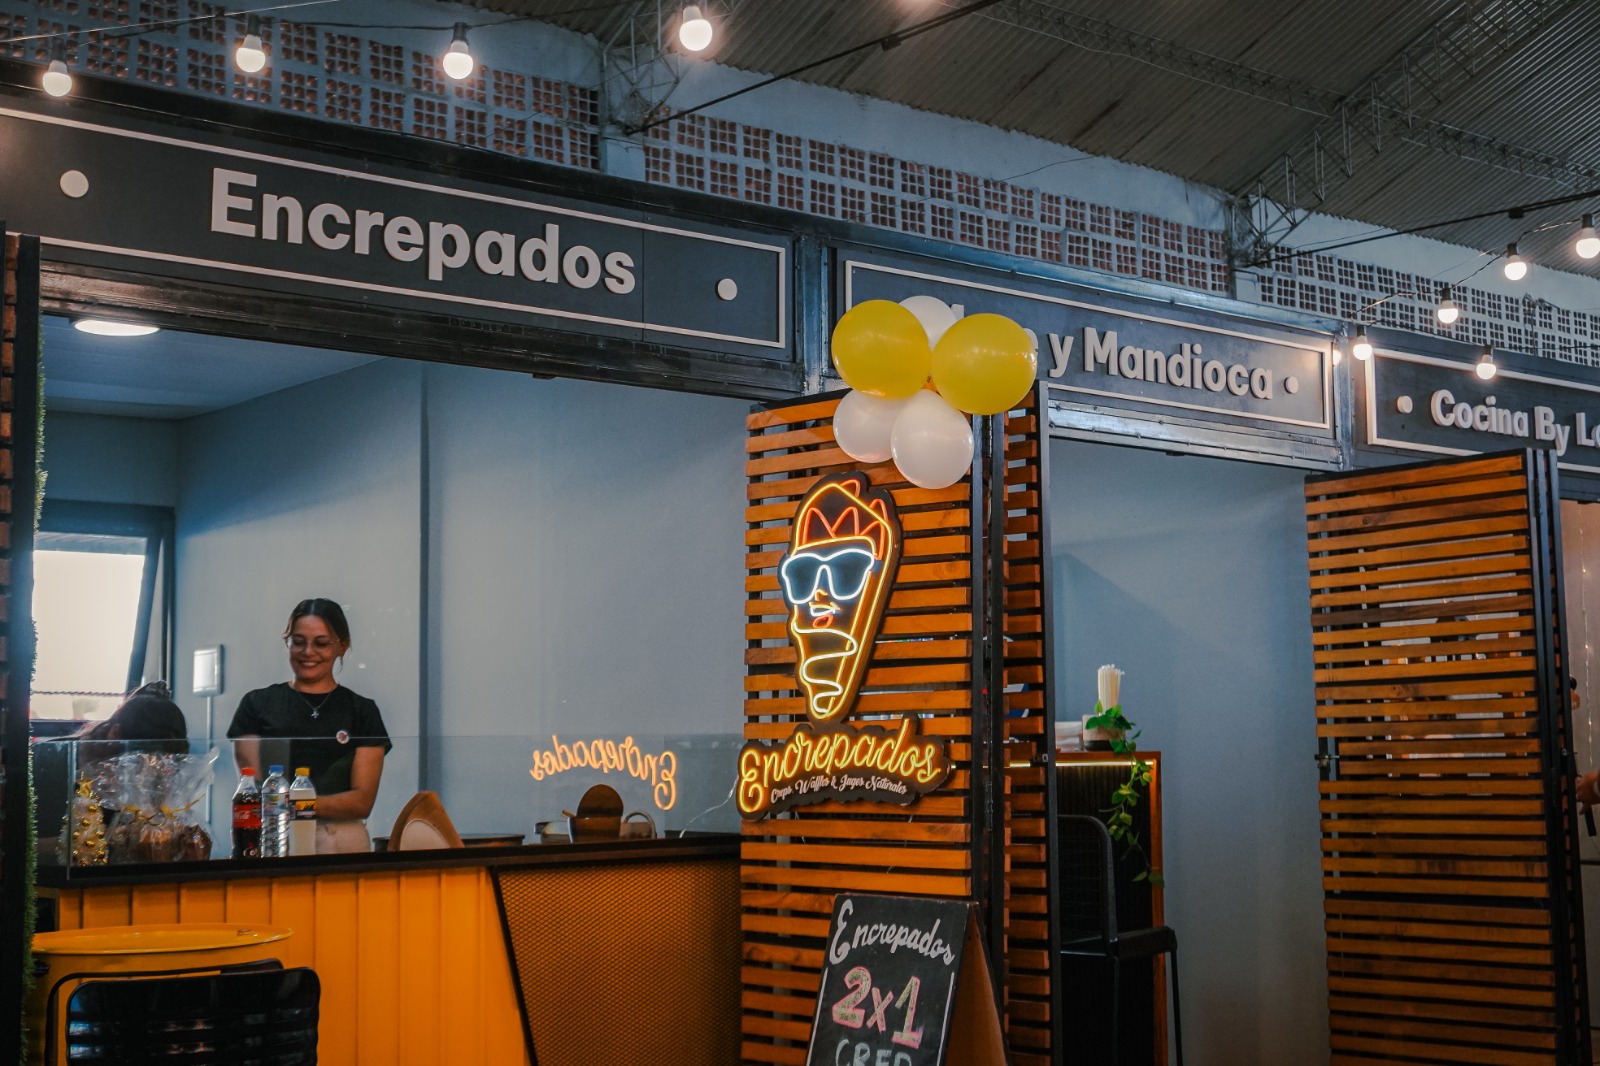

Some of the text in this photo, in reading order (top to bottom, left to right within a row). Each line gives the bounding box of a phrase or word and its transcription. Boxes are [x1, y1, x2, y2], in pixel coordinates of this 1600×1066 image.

[210, 167, 636, 295] Encrepados
[1047, 332, 1074, 378] y
[1083, 326, 1273, 400] Mandioca
[1431, 389, 1529, 437] Cocina
[1534, 405, 1571, 456] By
[865, 775, 908, 795] Naturales
[829, 898, 955, 966] Encrepados
[832, 965, 924, 1050] 2x1
